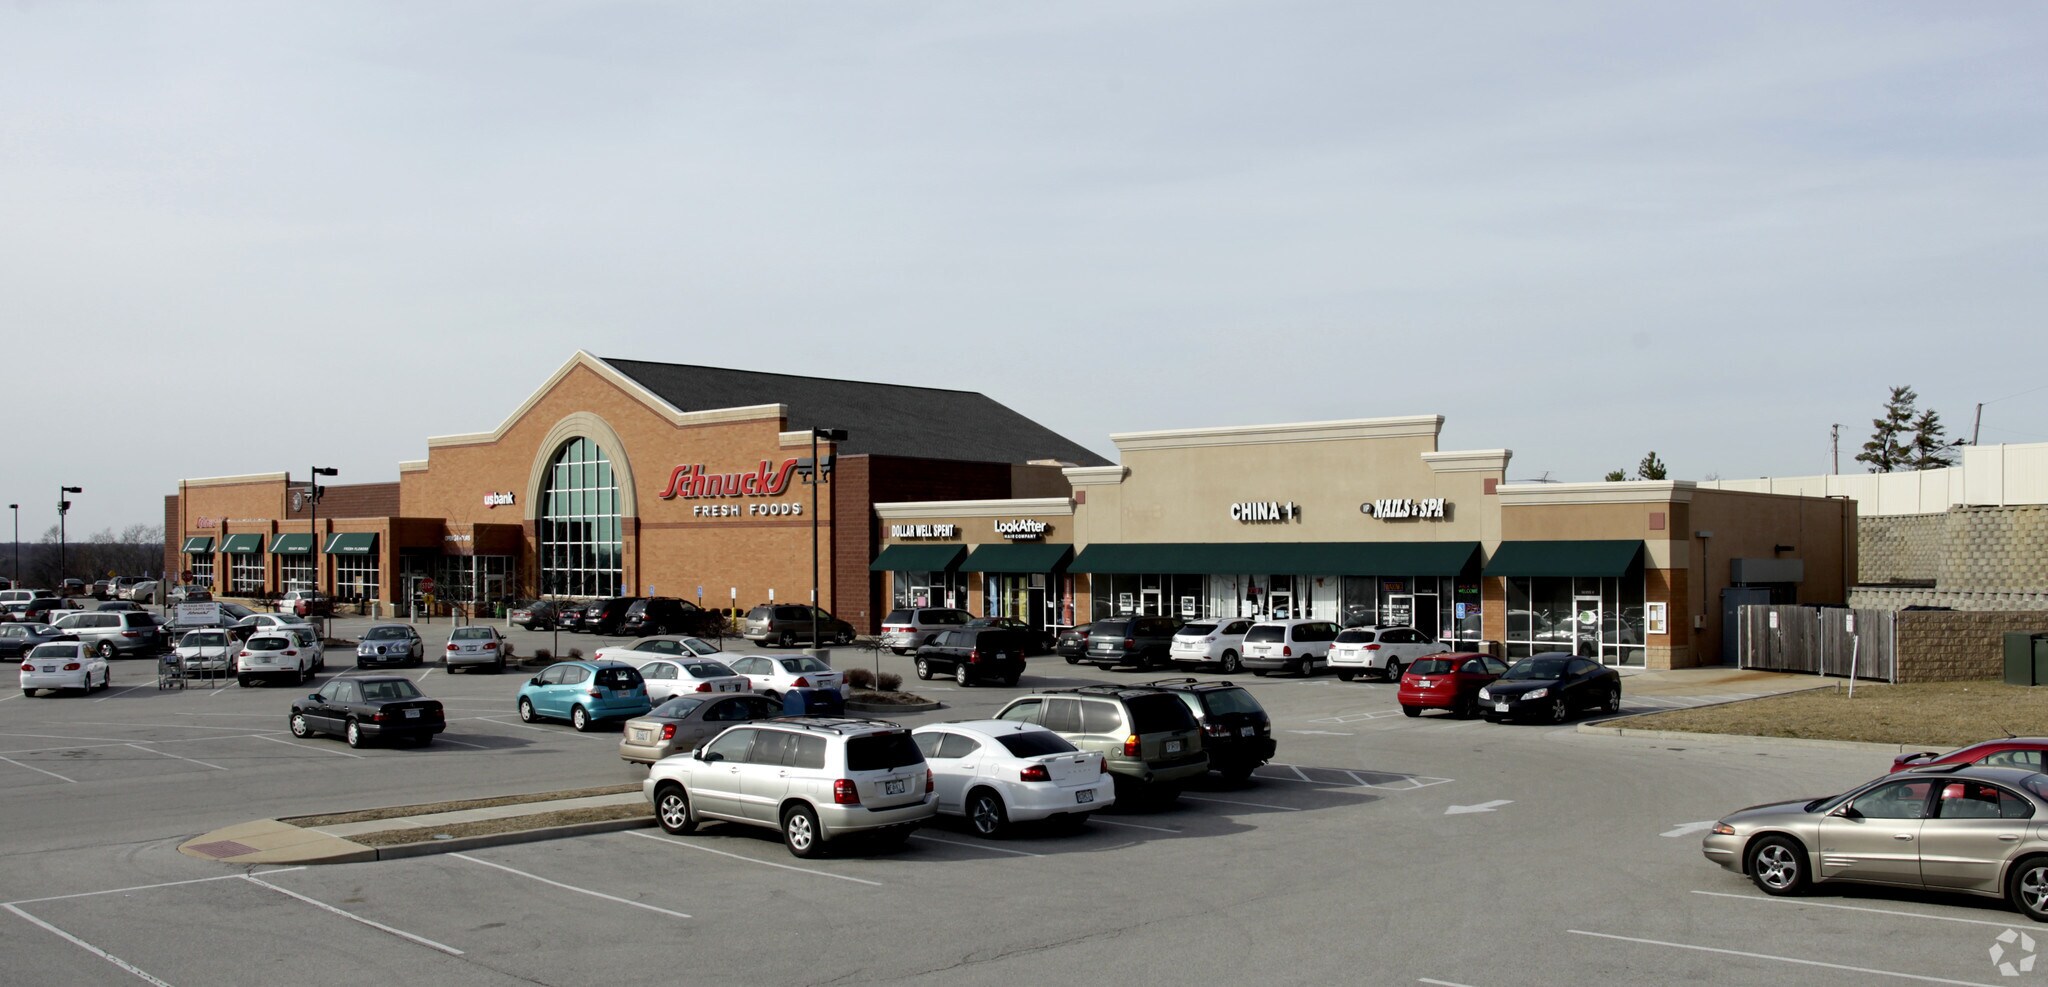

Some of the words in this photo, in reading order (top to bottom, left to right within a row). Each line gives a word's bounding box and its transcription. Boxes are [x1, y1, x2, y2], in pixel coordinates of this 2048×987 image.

[659, 458, 797, 498] Schnucks
[693, 504, 739, 517] FRESH
[749, 502, 802, 515] FOODS
[1230, 502, 1280, 521] CHINA
[1286, 501, 1294, 519] 1
[1373, 499, 1412, 518] NAILS
[1411, 504, 1418, 516] &
[1419, 497, 1445, 518] SPA
[891, 525, 915, 537] DOLLAR
[915, 525, 932, 537] WELL
[933, 524, 954, 537] SPENT
[994, 519, 1047, 532] LookAfter
